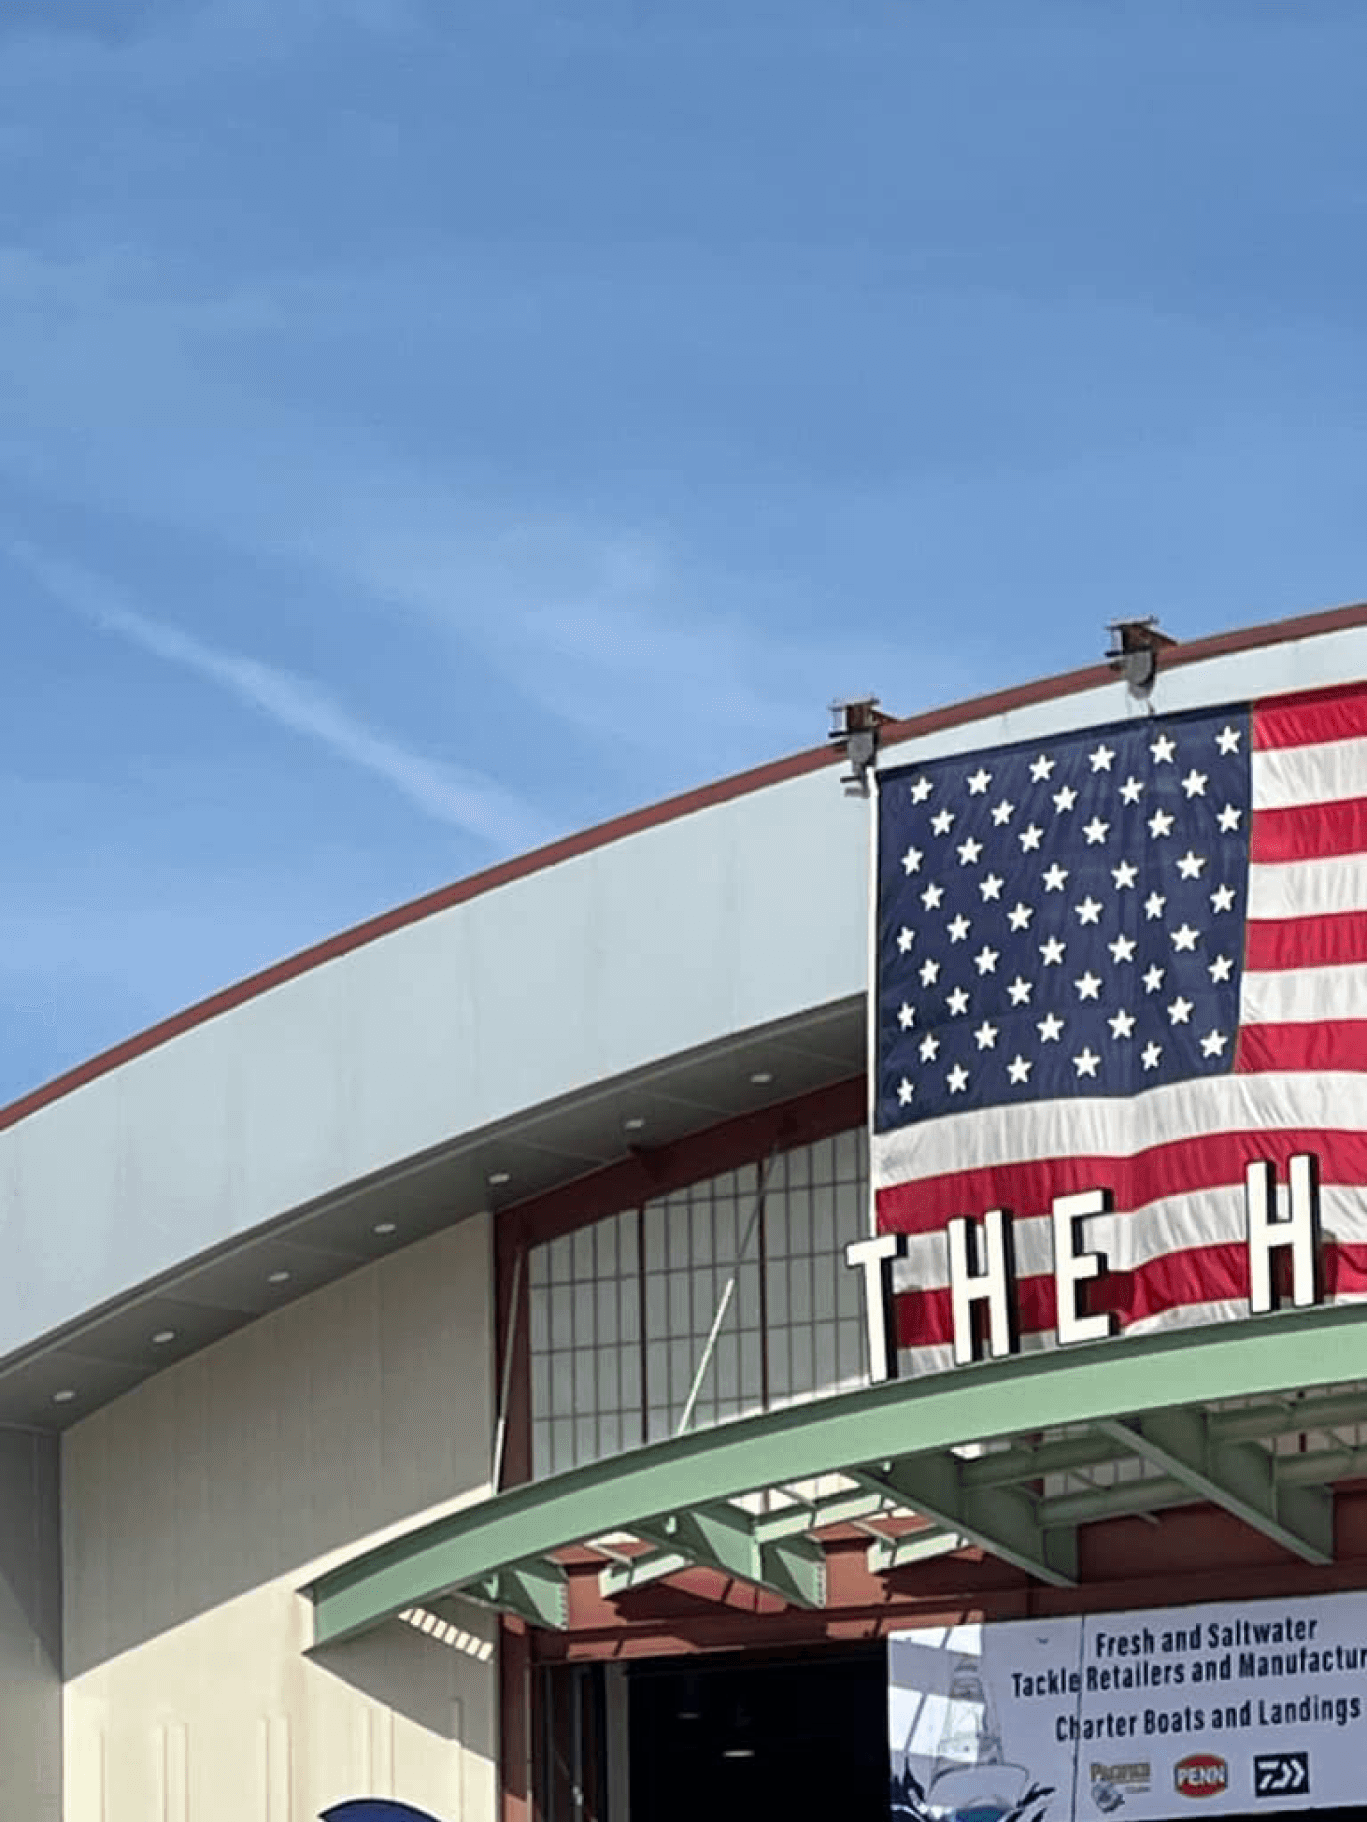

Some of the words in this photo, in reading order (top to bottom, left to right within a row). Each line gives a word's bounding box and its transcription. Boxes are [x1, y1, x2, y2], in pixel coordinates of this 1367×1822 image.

[846, 1187, 1116, 1384] THE
[1095, 1628, 1155, 1658] Fresh
[1161, 1623, 1201, 1653] and
[1207, 1617, 1318, 1649] Saltwater
[1011, 1665, 1081, 1698] Tackle
[1086, 1660, 1185, 1691] Retailers
[1192, 1654, 1231, 1682] and
[1055, 1712, 1138, 1742] Charter
[1143, 1706, 1205, 1735] Boats
[1211, 1700, 1252, 1730] and
[1258, 1695, 1362, 1726] Landings
[1177, 1764, 1226, 1787] PENN
